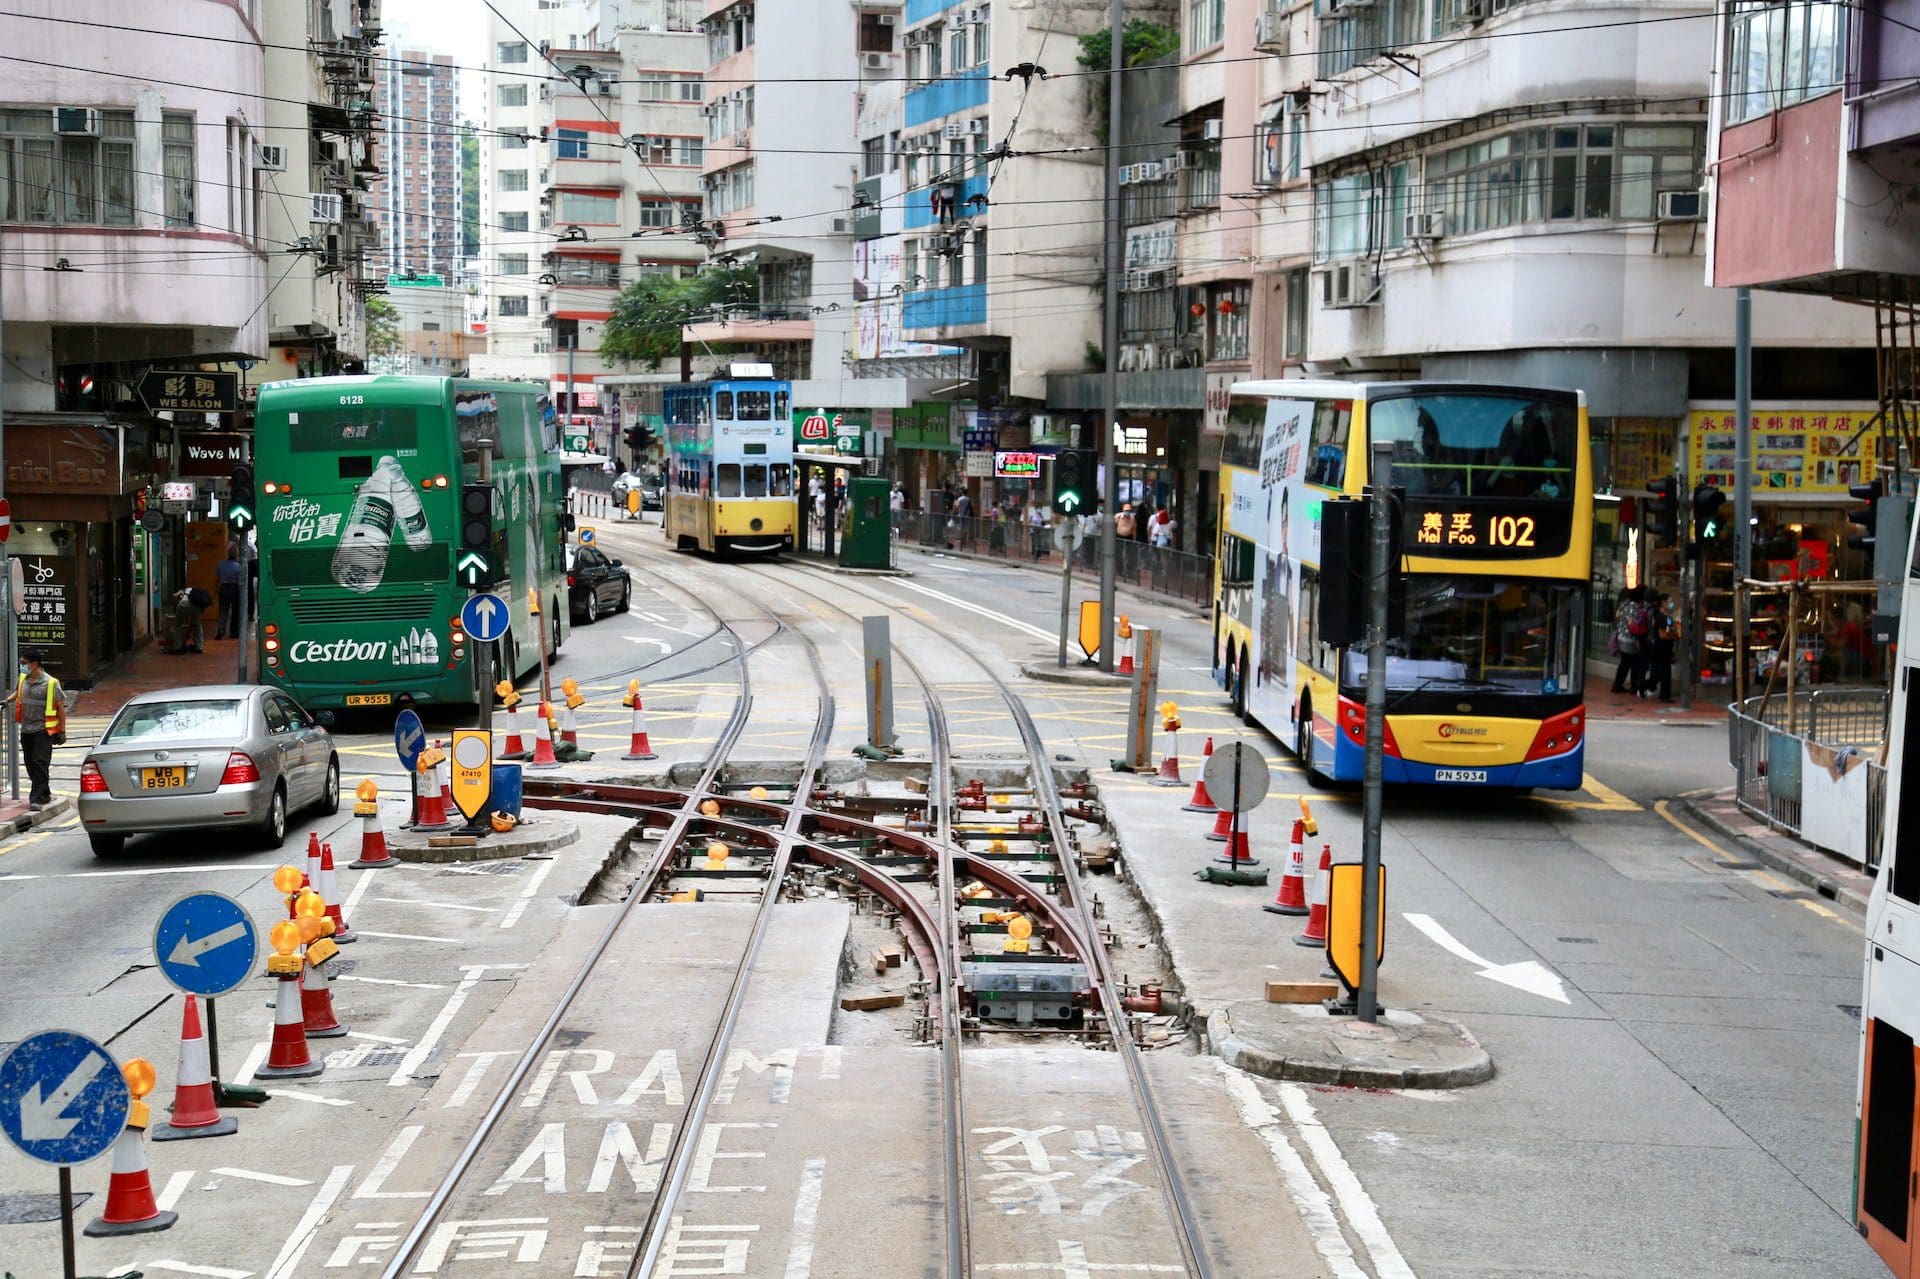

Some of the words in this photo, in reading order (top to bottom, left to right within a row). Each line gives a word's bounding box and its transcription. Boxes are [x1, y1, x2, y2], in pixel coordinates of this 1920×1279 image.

[159, 399, 178, 408] WE
[180, 399, 222, 409] SALON
[339, 395, 364, 405] 6128
[188, 446, 224, 460] Wave
[56, 461, 106, 484] Bar
[272, 498, 321, 522] 你我的
[289, 513, 342, 543] 怡寶
[1489, 516, 1535, 547] 102
[1448, 530, 1476, 545] Foo
[49, 614, 63, 623] $60
[52, 631, 66, 639] $45
[289, 639, 387, 664] C'estbon
[349, 696, 361, 705] UR
[365, 695, 389, 705] 9555
[154, 767, 173, 778] MB
[1437, 771, 1453, 780] PN
[1456, 772, 1484, 781] 5934
[147, 777, 180, 788] 8913
[444, 1048, 799, 1109] TRAM
[350, 1122, 778, 1200] LANE
